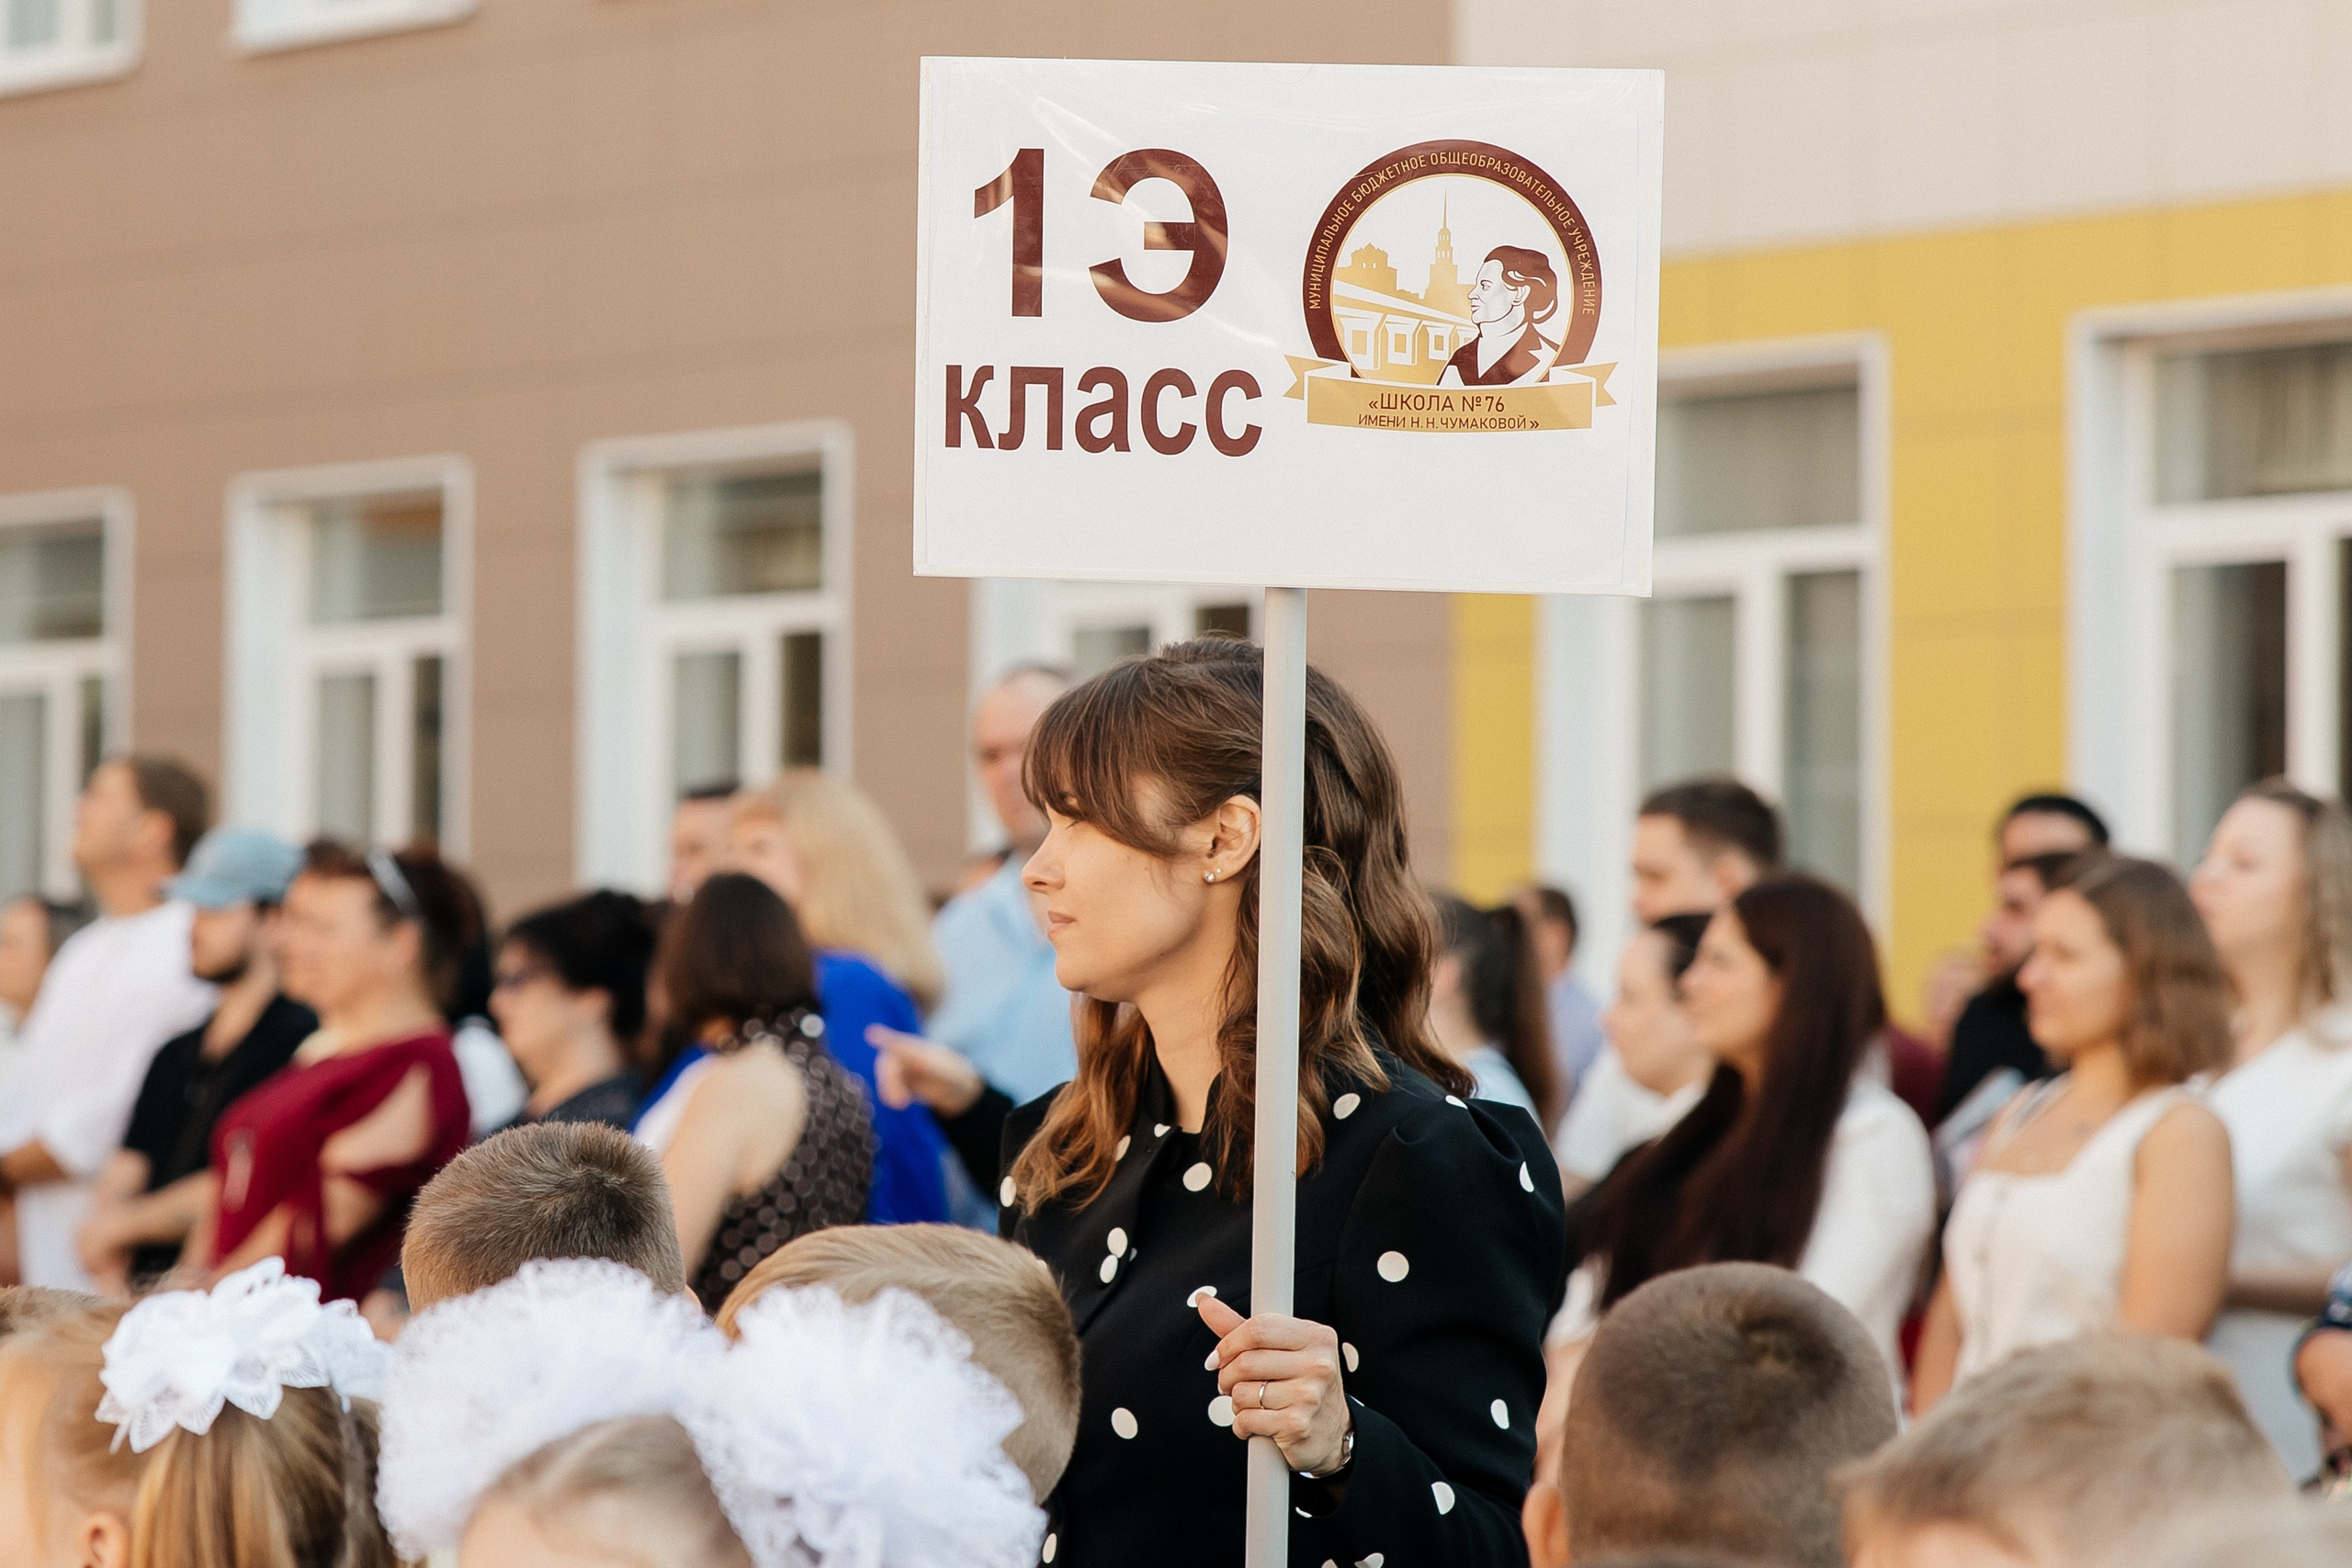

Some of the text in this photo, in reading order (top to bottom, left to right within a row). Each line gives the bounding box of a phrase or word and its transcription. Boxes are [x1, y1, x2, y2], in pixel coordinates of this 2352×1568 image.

[974, 148, 1229, 323] 1Э
[1309, 151, 1595, 315] МУНИЦИПАЛЬНОЕ БЮДЖЕТНОЕ ОБЩЕОБРАЗОВАТЕЛЬНОЕ УЧРЕЖДЕНИЕ
[944, 365, 1263, 457] класс
[1358, 413, 1406, 427] ИМЕНИ
[1368, 393, 1454, 412] «ШКОЛА
